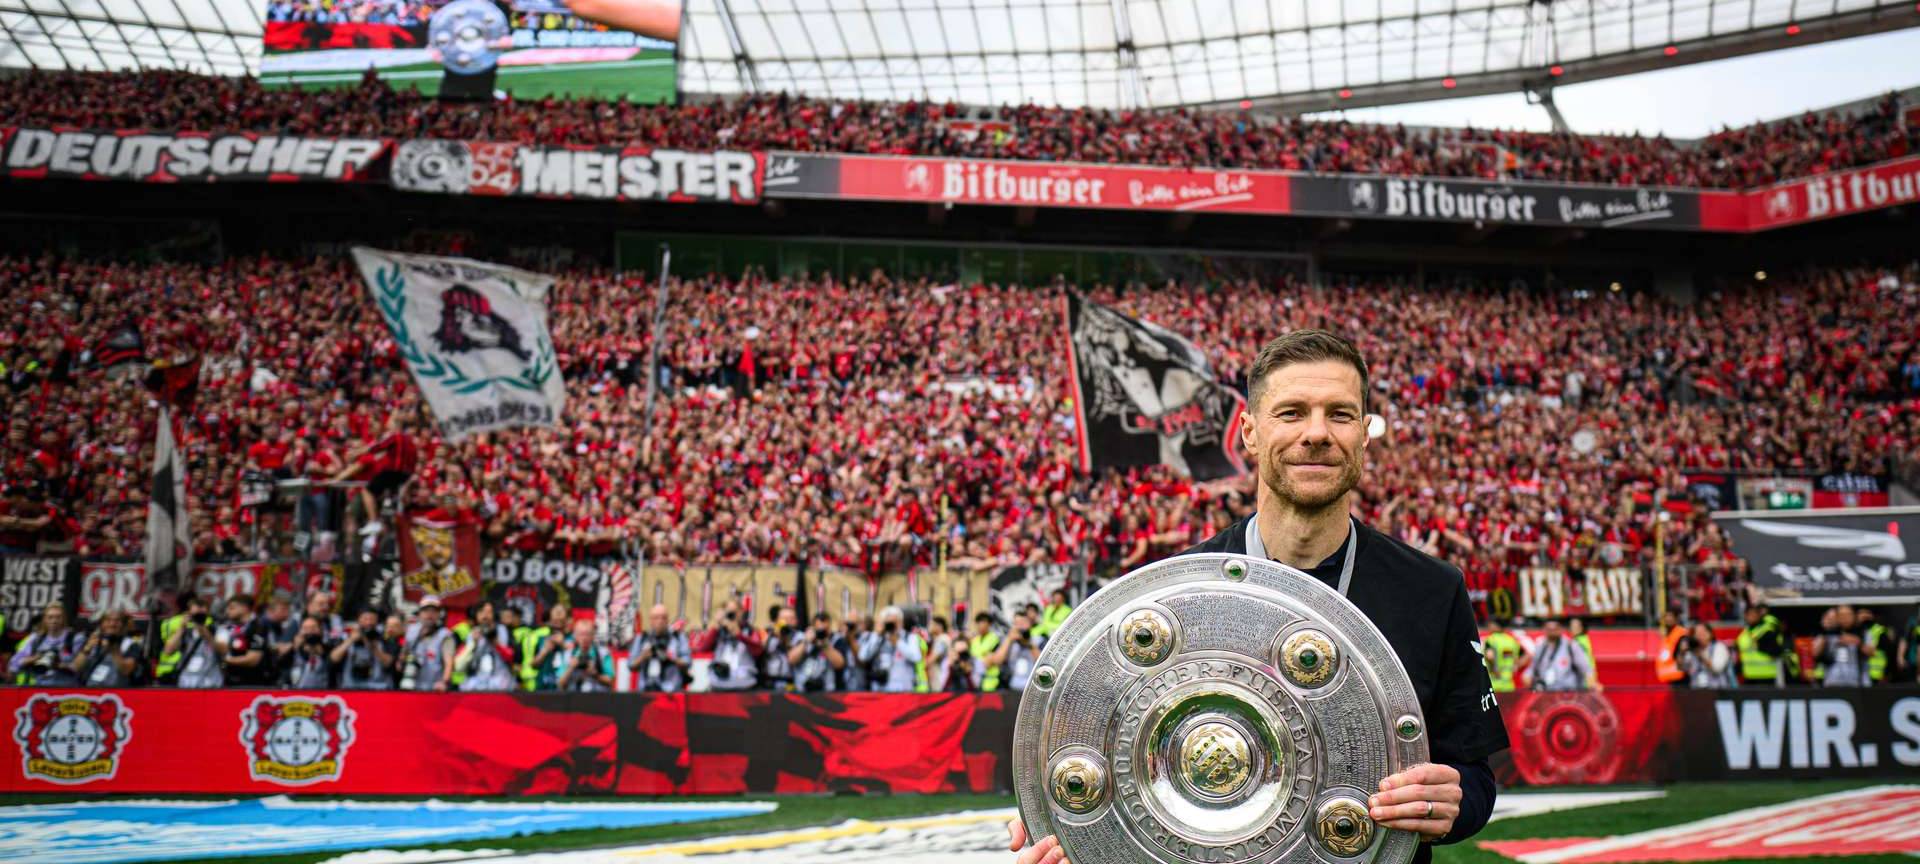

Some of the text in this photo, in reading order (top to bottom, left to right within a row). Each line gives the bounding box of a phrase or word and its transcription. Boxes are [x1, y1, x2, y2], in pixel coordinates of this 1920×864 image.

[515, 146, 757, 201] MEISTER
[943, 162, 1106, 204] Bitburger
[1386, 179, 1537, 222] Bitburger
[1806, 171, 1920, 219] Bitbu
[4, 556, 71, 582] WEST
[523, 559, 600, 593] BOYZ
[0, 584, 66, 609] SIDE
[1715, 699, 1878, 770] WIR.
